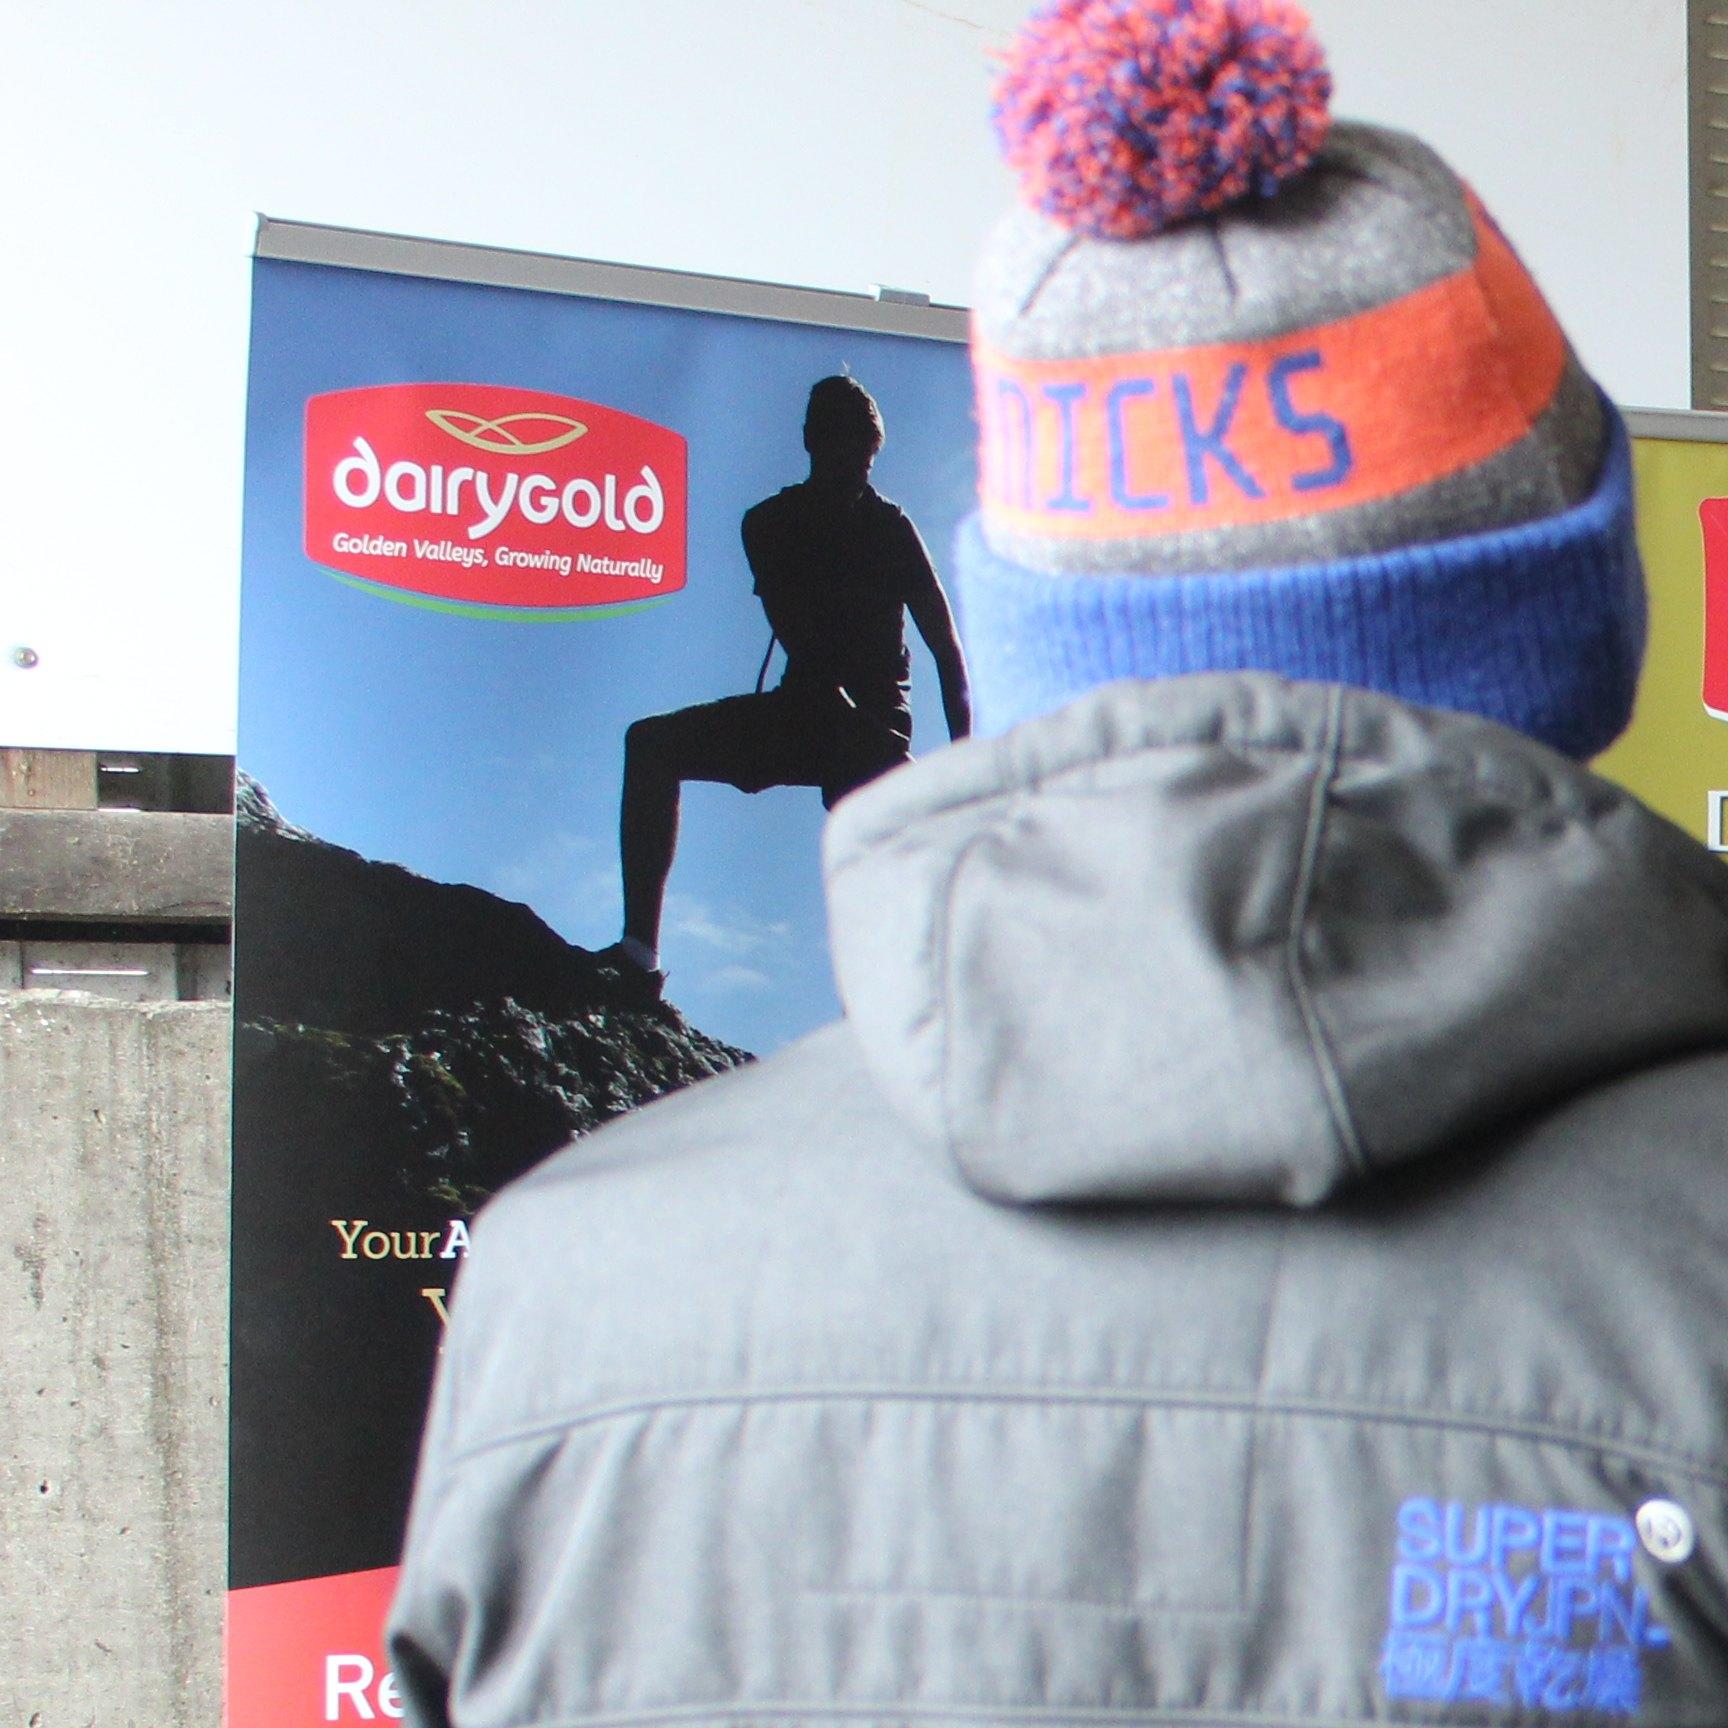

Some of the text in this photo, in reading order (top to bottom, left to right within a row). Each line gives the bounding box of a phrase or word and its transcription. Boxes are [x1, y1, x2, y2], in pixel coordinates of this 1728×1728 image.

[332, 532, 664, 584] Golden Valleys, Growing Naturally
[1396, 1495, 1638, 1583] SUPER
